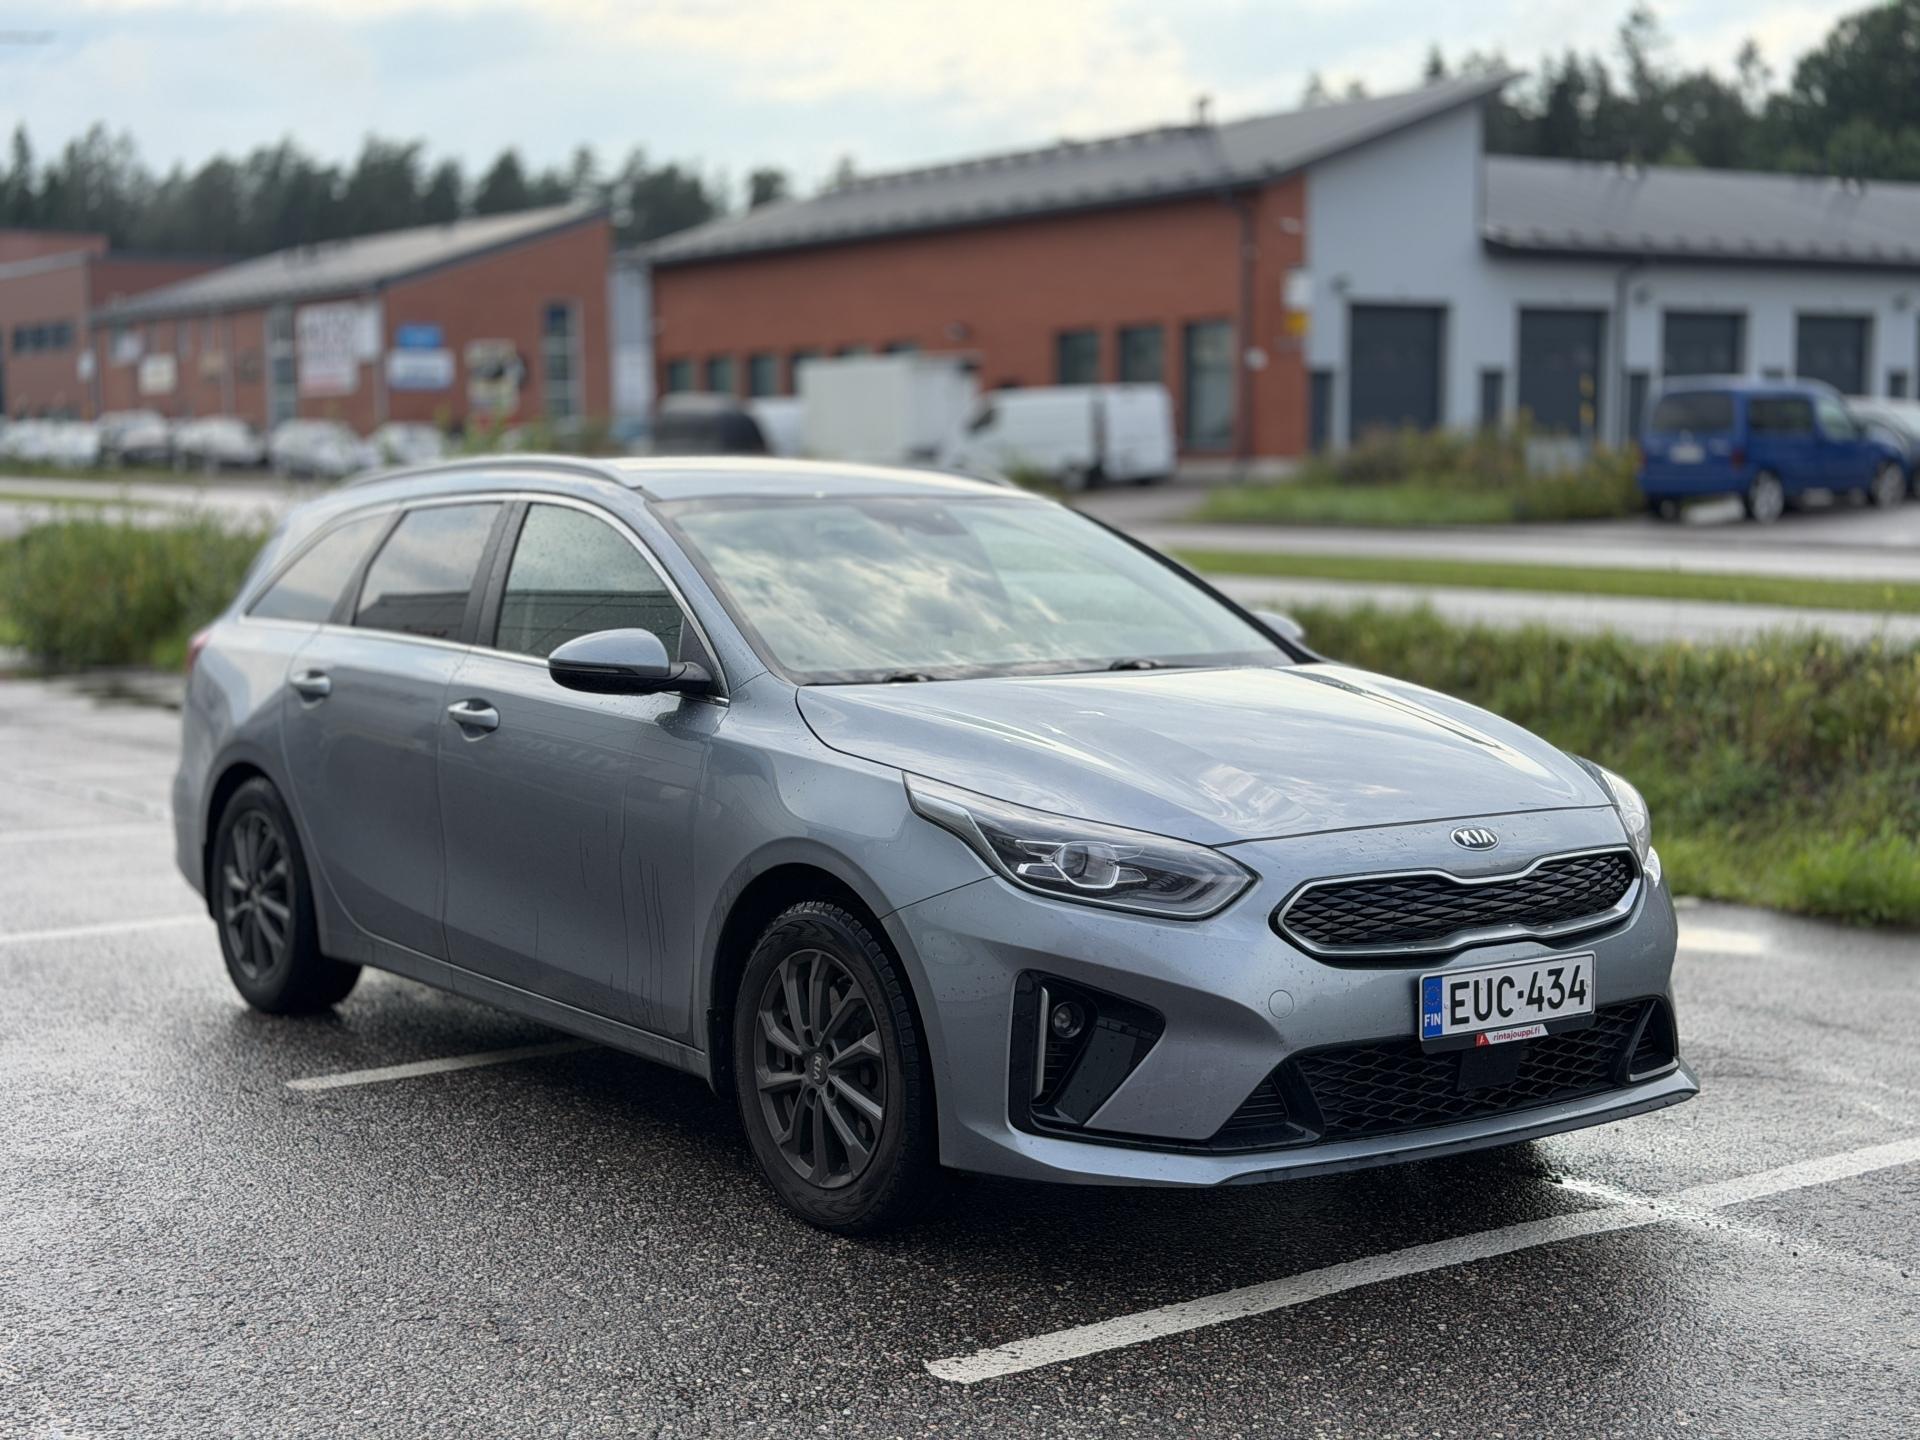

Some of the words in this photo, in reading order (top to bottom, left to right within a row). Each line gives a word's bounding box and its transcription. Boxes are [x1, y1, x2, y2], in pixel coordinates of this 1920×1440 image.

[1457, 829, 1495, 845] KIA
[1450, 965, 1587, 1026] EUC-434
[1424, 1012, 1441, 1027] FIN
[1493, 1025, 1541, 1041] rintajouppi.fi
[814, 1055, 822, 1080] KIA
